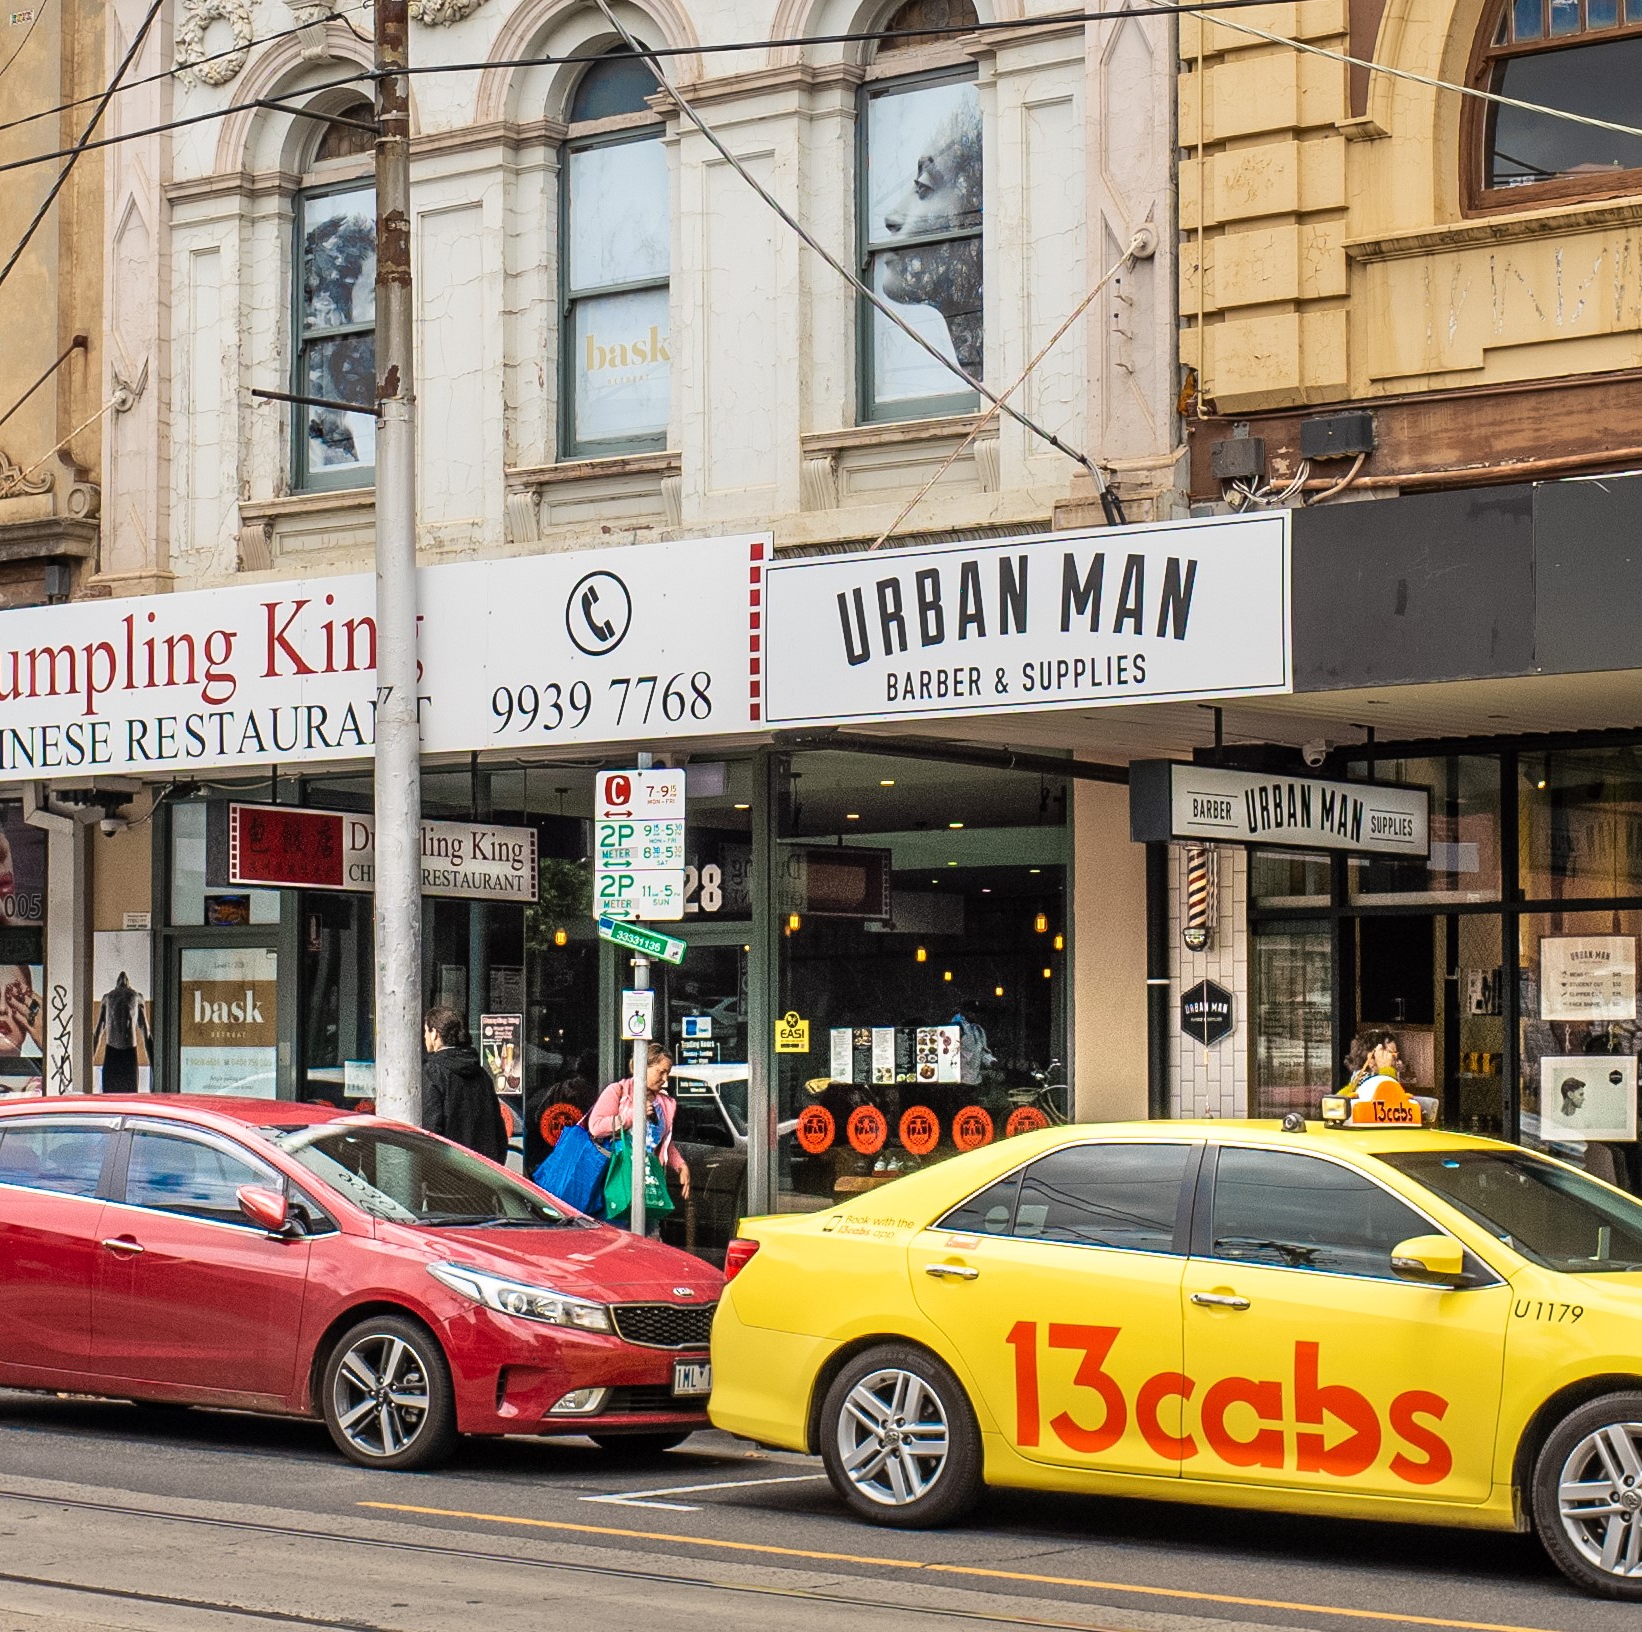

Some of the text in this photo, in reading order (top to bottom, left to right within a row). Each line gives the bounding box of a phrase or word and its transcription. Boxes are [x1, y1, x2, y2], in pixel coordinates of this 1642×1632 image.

[585, 325, 671, 371] bask
[836, 553, 1198, 666] URBAN MAN
[259, 594, 424, 684] Kin
[886, 653, 1147, 702] BARBER & SUPPLIES
[492, 671, 713, 734] 9939 7768
[1193, 798, 1231, 820] BARBER
[1245, 783, 1363, 843] URBAN MAN
[600, 824, 634, 847] 2P
[1371, 815, 1413, 837] SUPPLIES
[471, 831, 524, 871] King
[602, 849, 630, 859] METER
[422, 868, 524, 893] RESTAURANT
[600, 875, 634, 897] 2P
[603, 899, 632, 909] METER
[194, 990, 264, 1023] bask
[1211, 1002, 1228, 1014] MAN
[780, 1029, 805, 1039] EASI
[1373, 1101, 1413, 1122] 13cabs
[844, 1215, 915, 1230] Book with the
[872, 1229, 895, 1239] app
[1005, 1321, 1453, 1485] 13cabs
